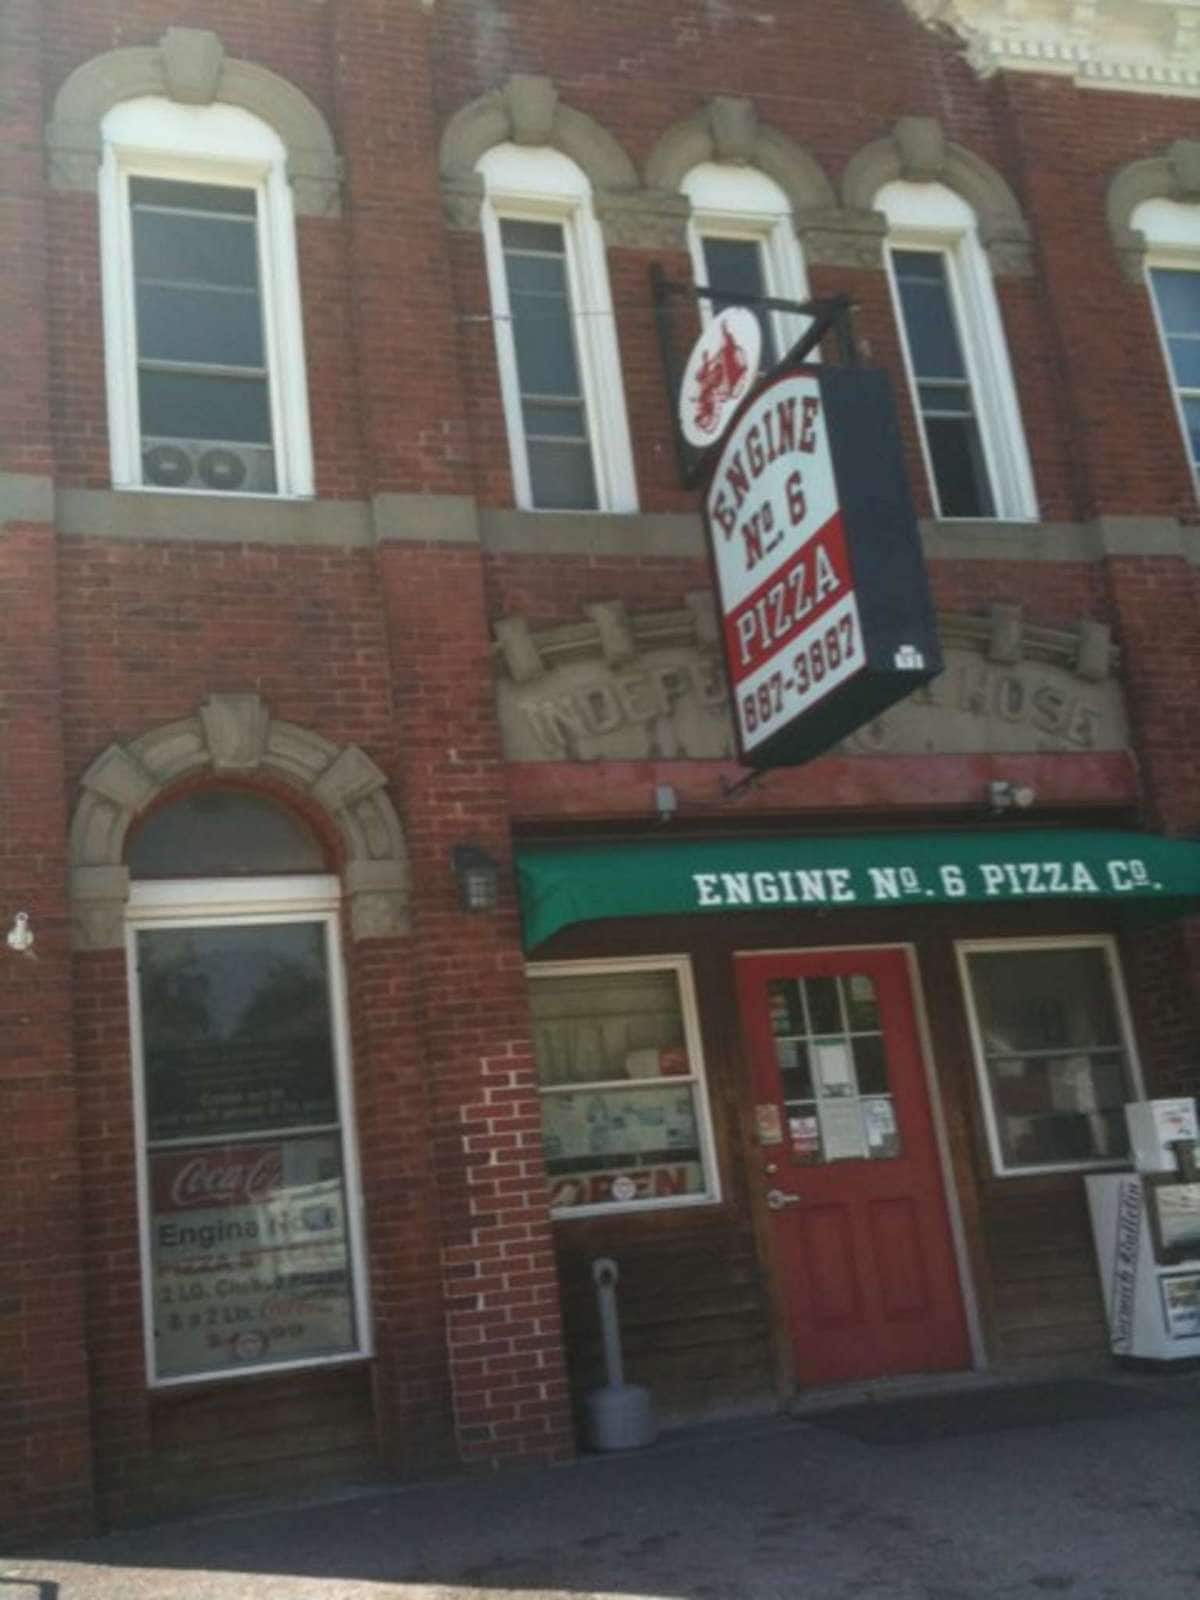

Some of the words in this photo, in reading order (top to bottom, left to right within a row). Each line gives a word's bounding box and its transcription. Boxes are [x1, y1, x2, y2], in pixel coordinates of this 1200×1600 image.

[709, 395, 820, 542] ENGINE
[784, 469, 808, 527] 6
[735, 545, 840, 666] PIZZA
[743, 613, 856, 734] 887-3887
[692, 868, 856, 906] ENGINE
[940, 864, 968, 897] 6
[979, 861, 1099, 895] PIZZA
